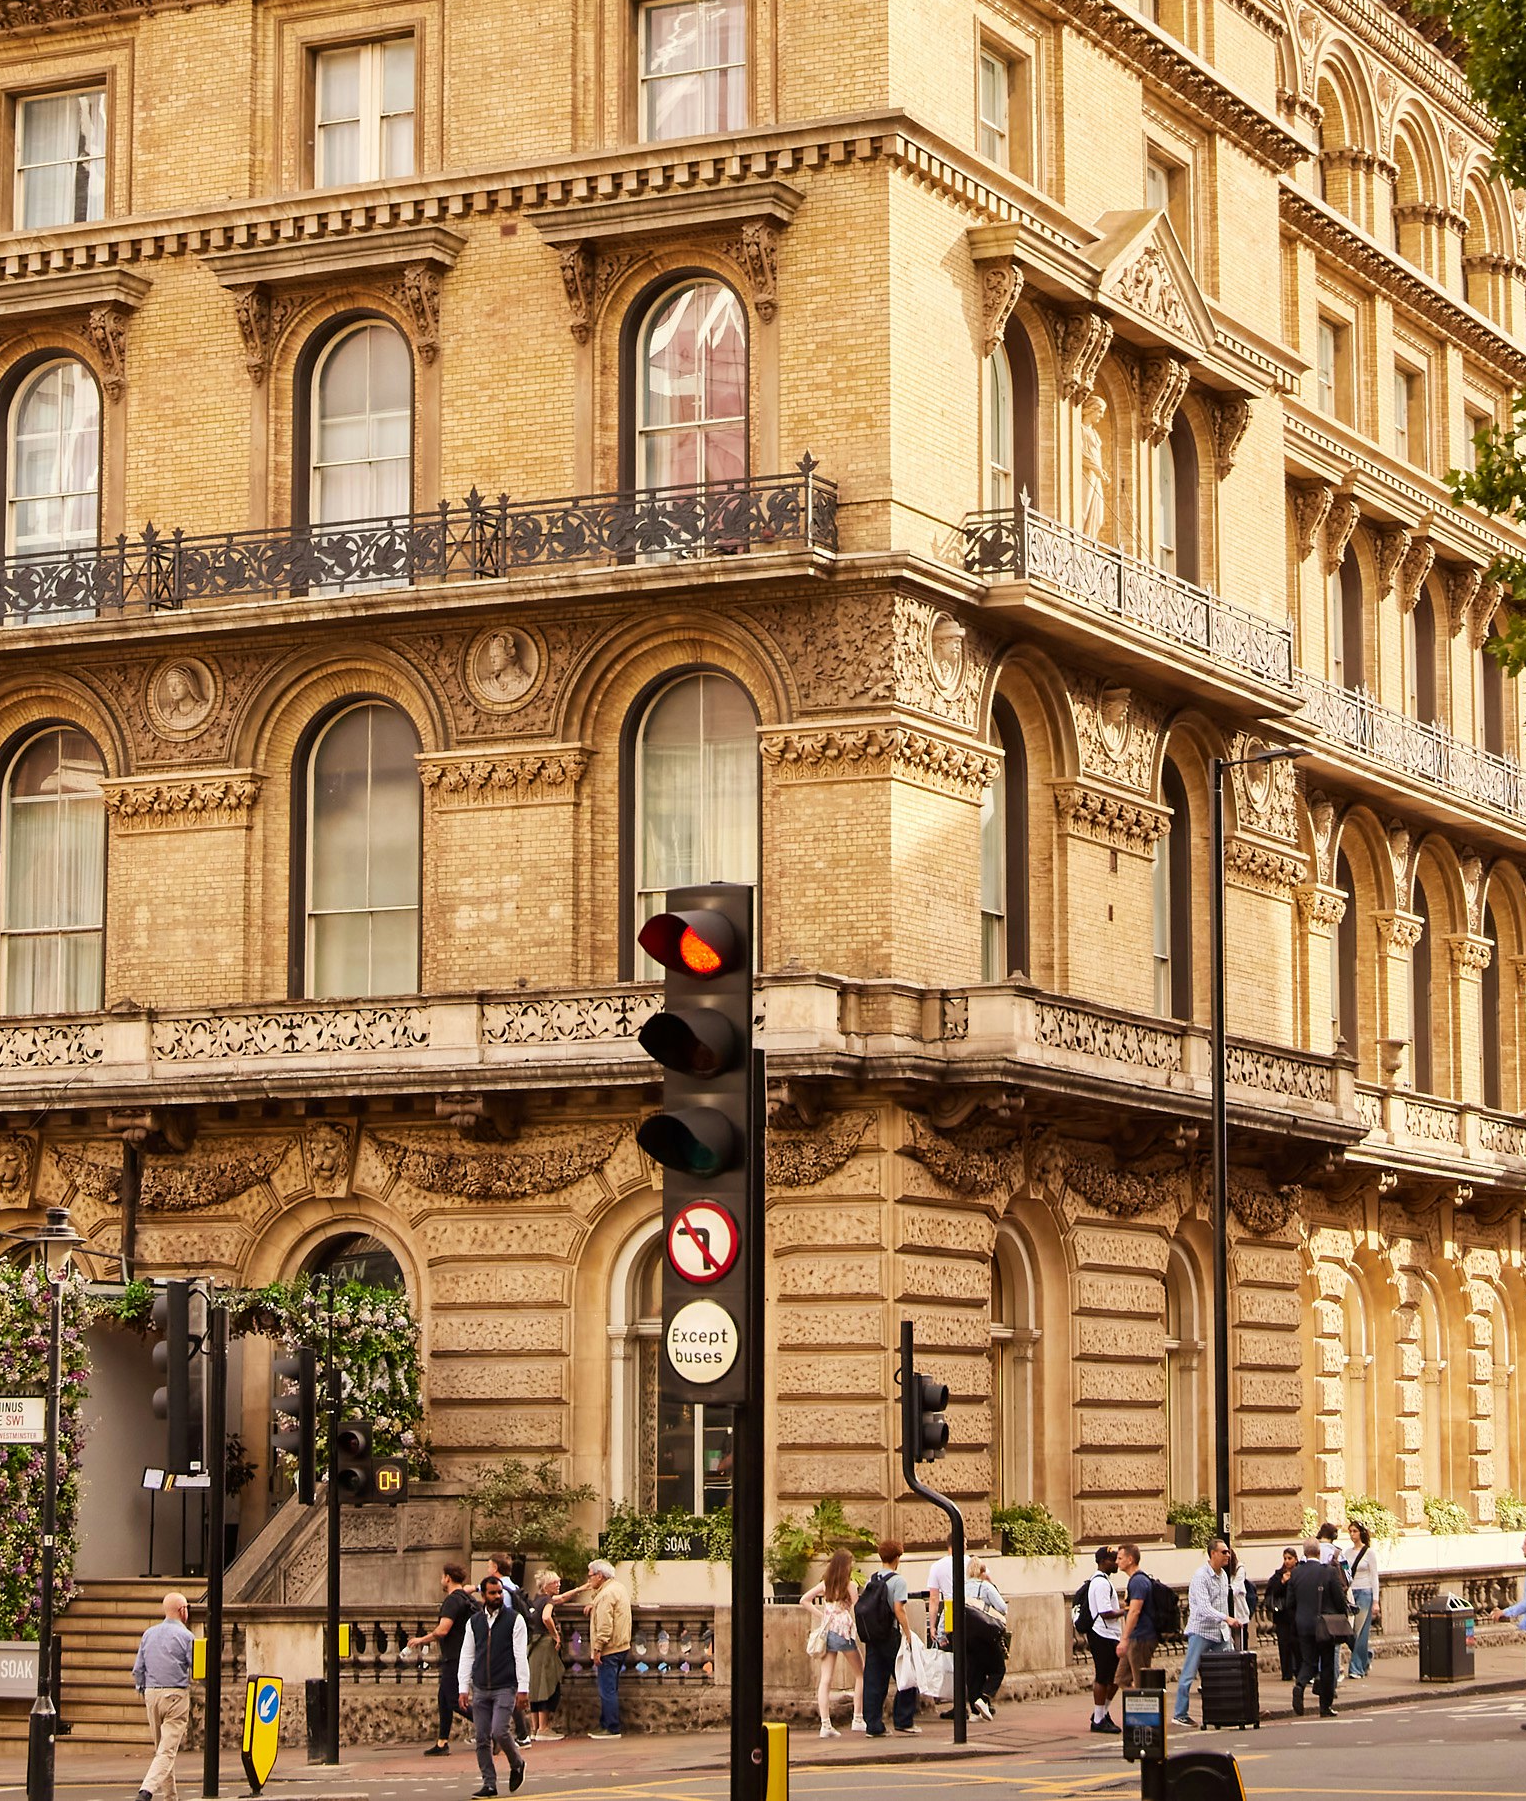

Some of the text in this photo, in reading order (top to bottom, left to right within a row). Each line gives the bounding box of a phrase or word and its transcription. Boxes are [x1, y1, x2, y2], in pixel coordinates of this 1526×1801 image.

[672, 1327, 729, 1346] Except
[675, 1347, 723, 1363] buses
[6, 1415, 24, 1426] SW1
[378, 1471, 400, 1491] 04
[664, 1536, 692, 1551] SOAK
[0, 1659, 33, 1679] SOAK
